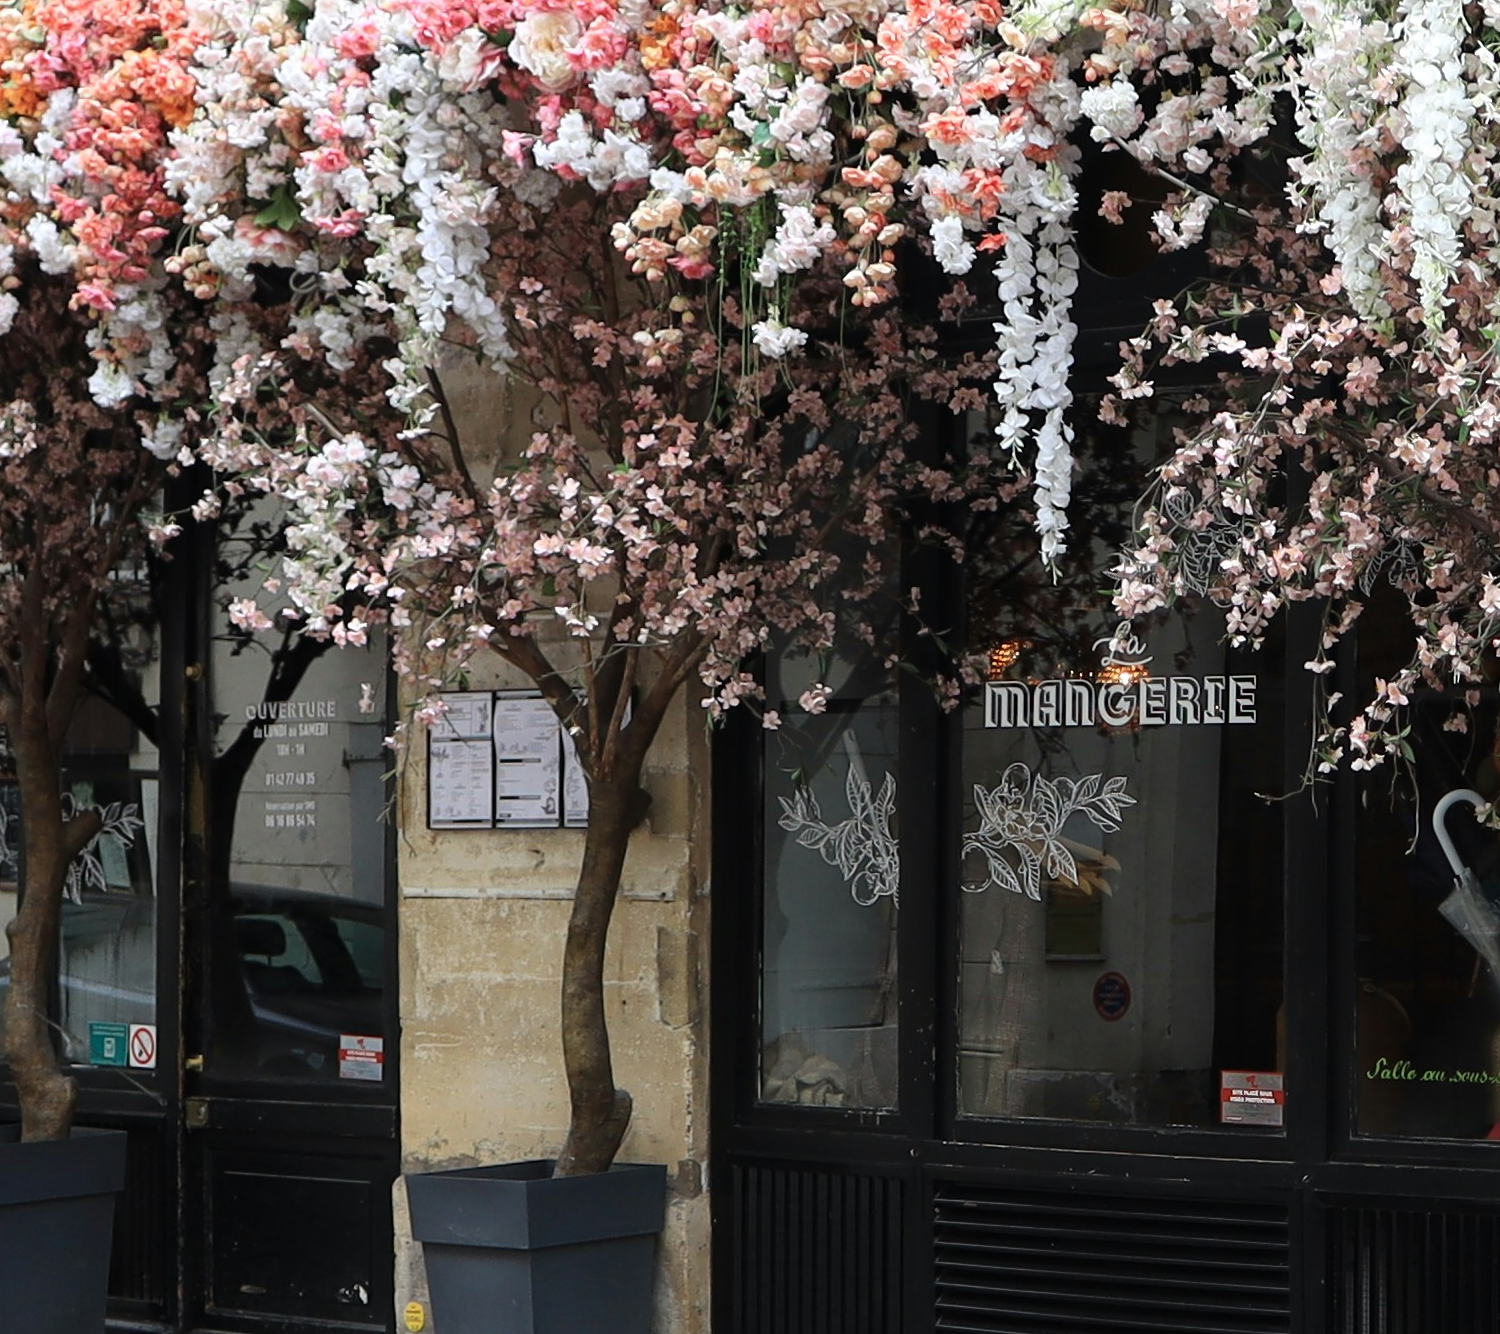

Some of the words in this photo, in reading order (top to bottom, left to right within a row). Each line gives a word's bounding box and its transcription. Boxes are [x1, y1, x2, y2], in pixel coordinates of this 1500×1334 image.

[1092, 620, 1154, 667] La
[246, 701, 336, 720] OUVERTURE
[984, 675, 1257, 729] MANGERIE
[264, 723, 287, 738] LUNDI
[299, 722, 329, 736] SAMEDI
[265, 772, 275, 786] 01
[276, 772, 285, 786] 42
[286, 772, 295, 785] 77
[1366, 1057, 1417, 1080] Salle
[1420, 1070, 1446, 1082] au
